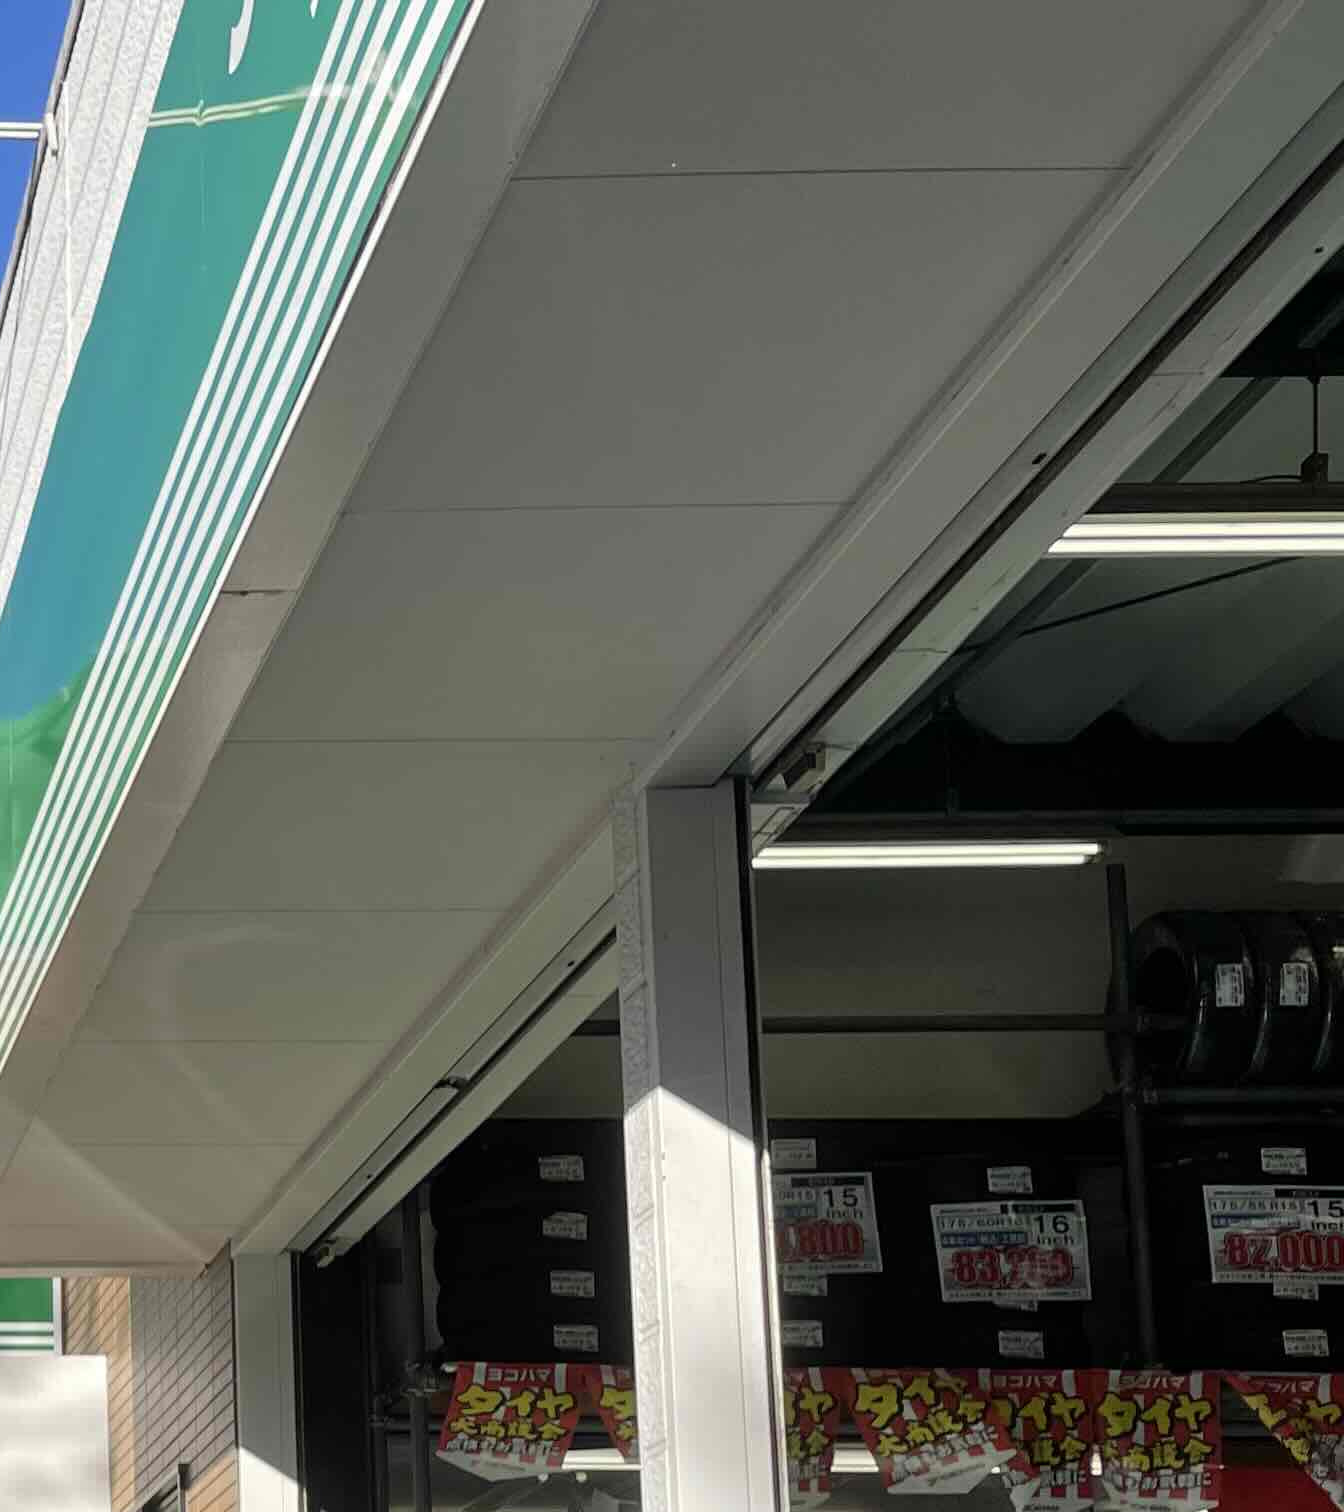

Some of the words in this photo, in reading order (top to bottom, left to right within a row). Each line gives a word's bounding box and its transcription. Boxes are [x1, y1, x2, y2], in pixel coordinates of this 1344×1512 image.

[823, 1188, 859, 1208] 15
[1308, 1200, 1344, 1217] 15
[1039, 1215, 1069, 1234] 16
[488, 1367, 552, 1382] ヨコハマ
[457, 1383, 576, 1418] タイヤ
[1097, 1392, 1213, 1438] タイヤ
